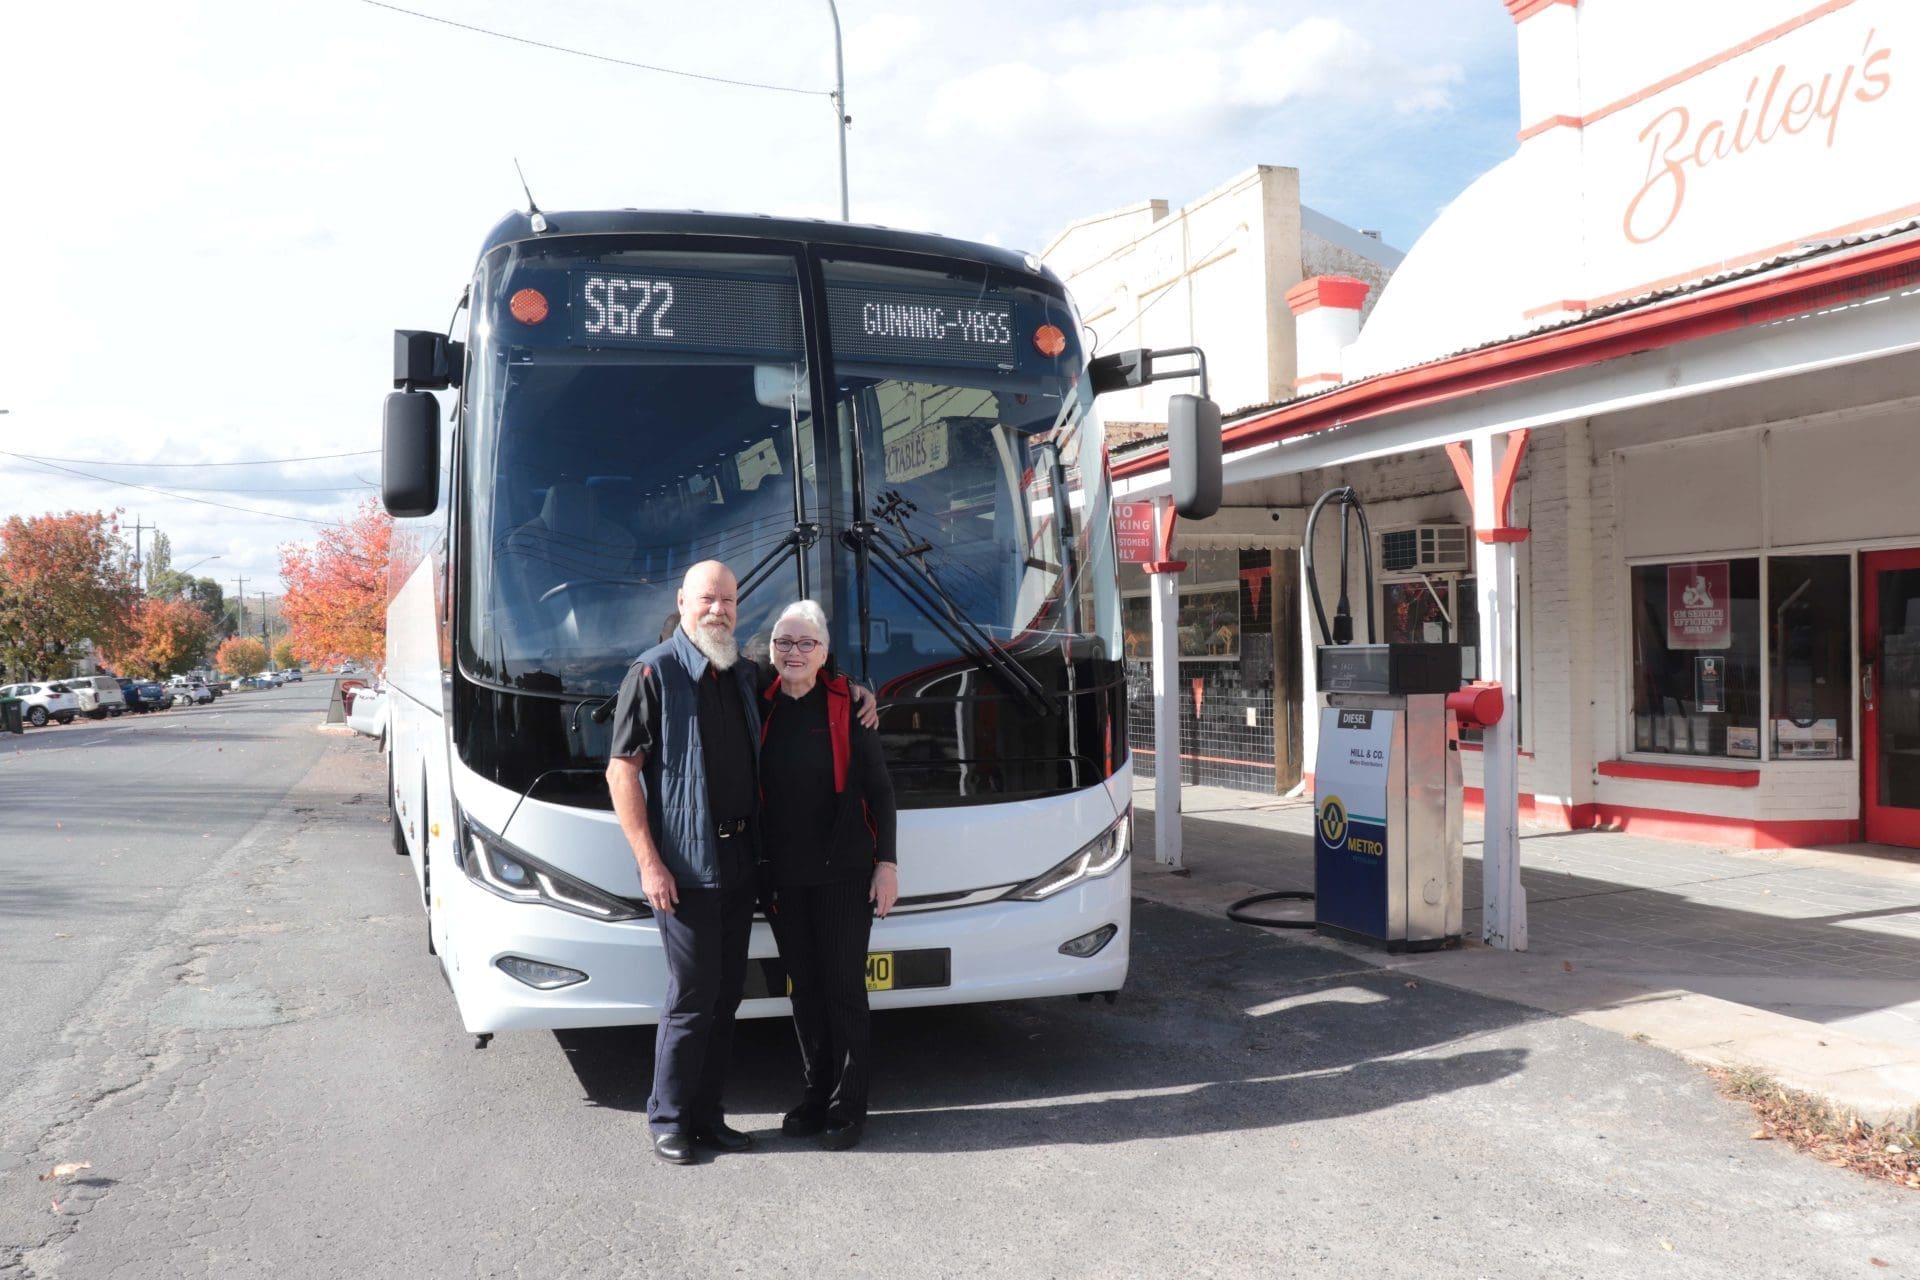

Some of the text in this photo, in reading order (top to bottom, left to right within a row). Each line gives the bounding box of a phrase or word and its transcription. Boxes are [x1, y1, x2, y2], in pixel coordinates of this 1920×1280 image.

[1623, 27, 1892, 244] Bailey's
[584, 277, 674, 337] S672
[863, 303, 1011, 344] GUNNING-YASS
[887, 434, 928, 477] CTABLES
[1115, 520, 1151, 531] KING
[1117, 537, 1150, 547] STOMERS
[1673, 609, 1724, 619] GM SERVICE
[1674, 618, 1724, 627] EFFICIENCY
[1683, 626, 1713, 635] AWARD
[1343, 713, 1366, 724] DIESEL
[1350, 748, 1384, 760] HILL & CO.
[1348, 838, 1383, 857] METRO
[866, 958, 889, 982] MO
